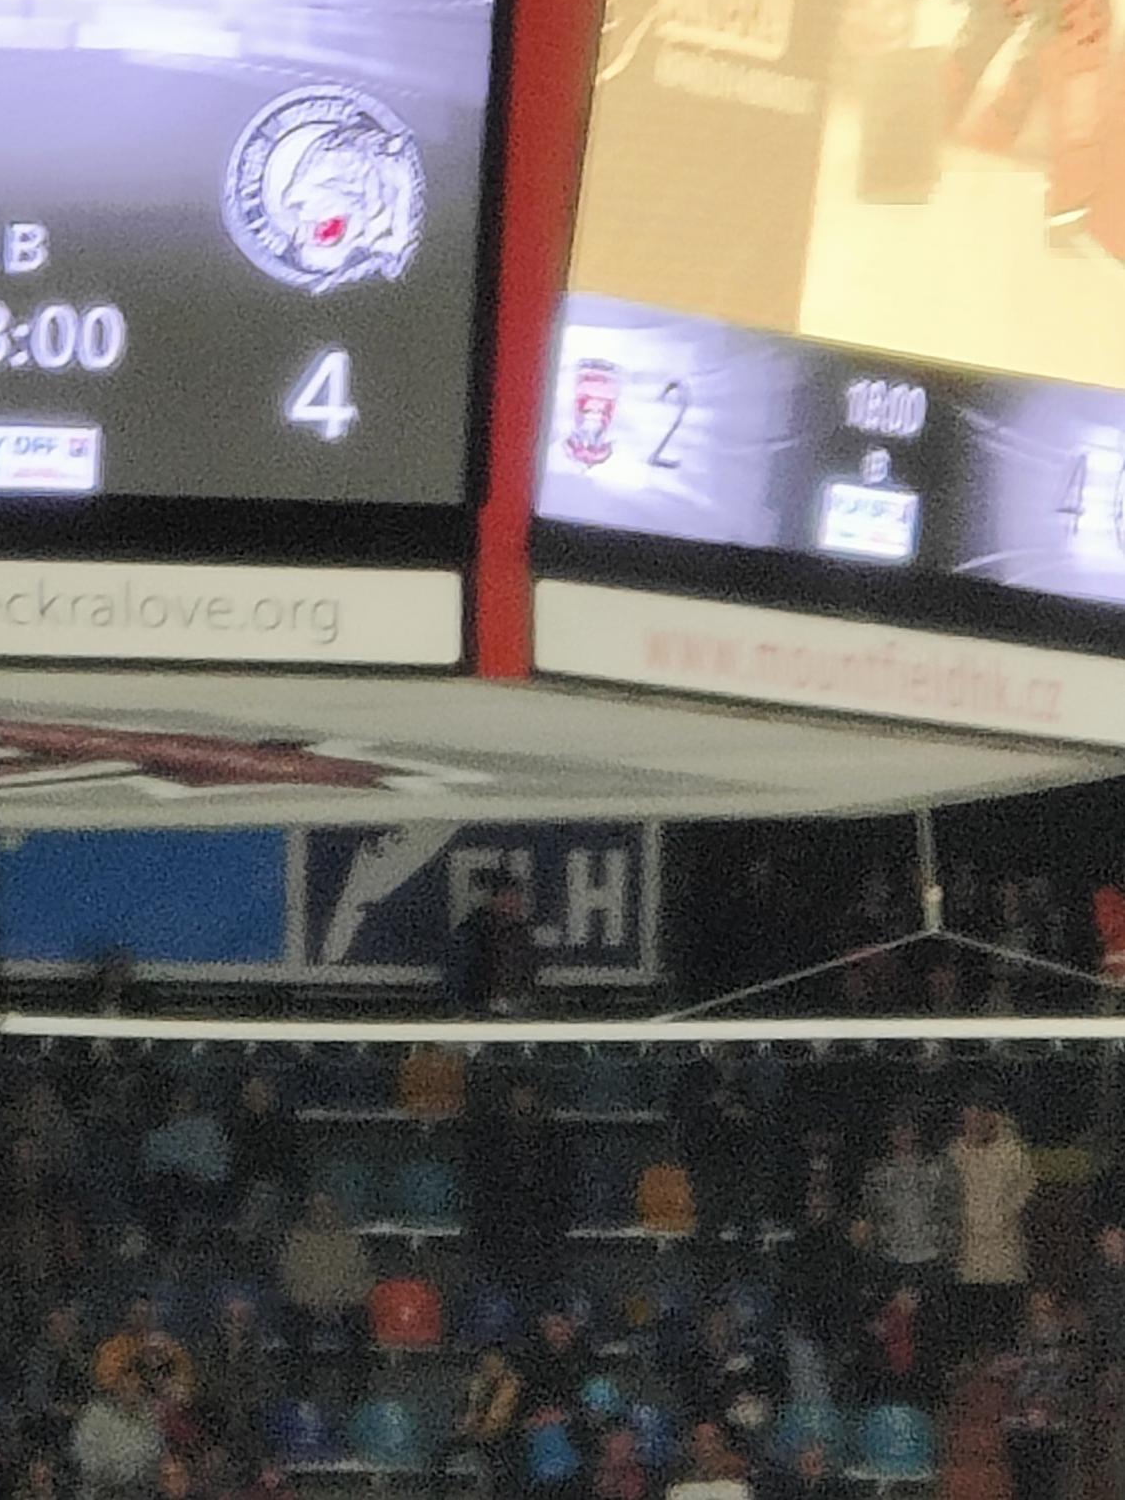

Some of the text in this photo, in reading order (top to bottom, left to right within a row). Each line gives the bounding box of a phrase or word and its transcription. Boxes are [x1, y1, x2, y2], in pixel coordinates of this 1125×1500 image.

[2, 222, 48, 274] B
[284, 348, 359, 442] 4
[647, 379, 691, 469] 2
